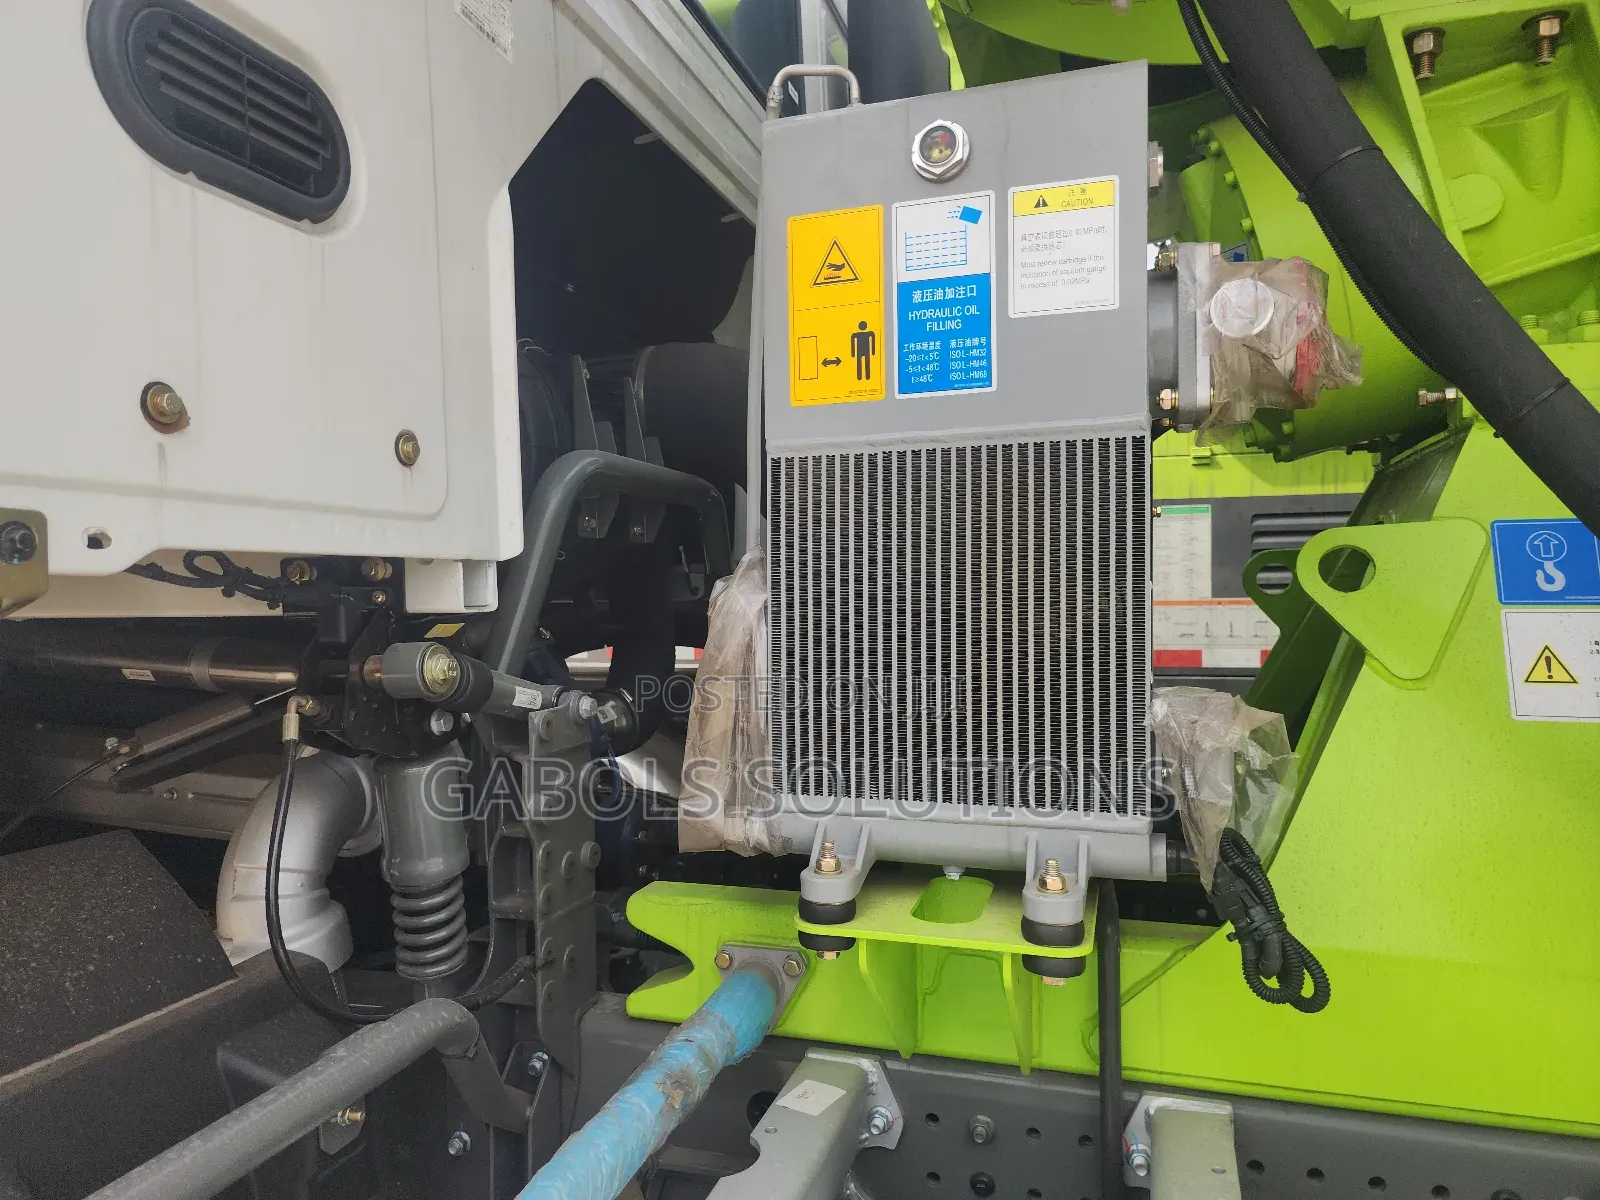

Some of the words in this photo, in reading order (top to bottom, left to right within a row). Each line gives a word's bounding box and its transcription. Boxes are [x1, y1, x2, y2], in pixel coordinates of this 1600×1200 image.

[1061, 197, 1094, 208] CAUTION
[912, 284, 977, 304] 液压油加注口
[908, 305, 962, 321] HYDRAULIC
[964, 304, 980, 316] OIL
[926, 318, 962, 332] FILLING
